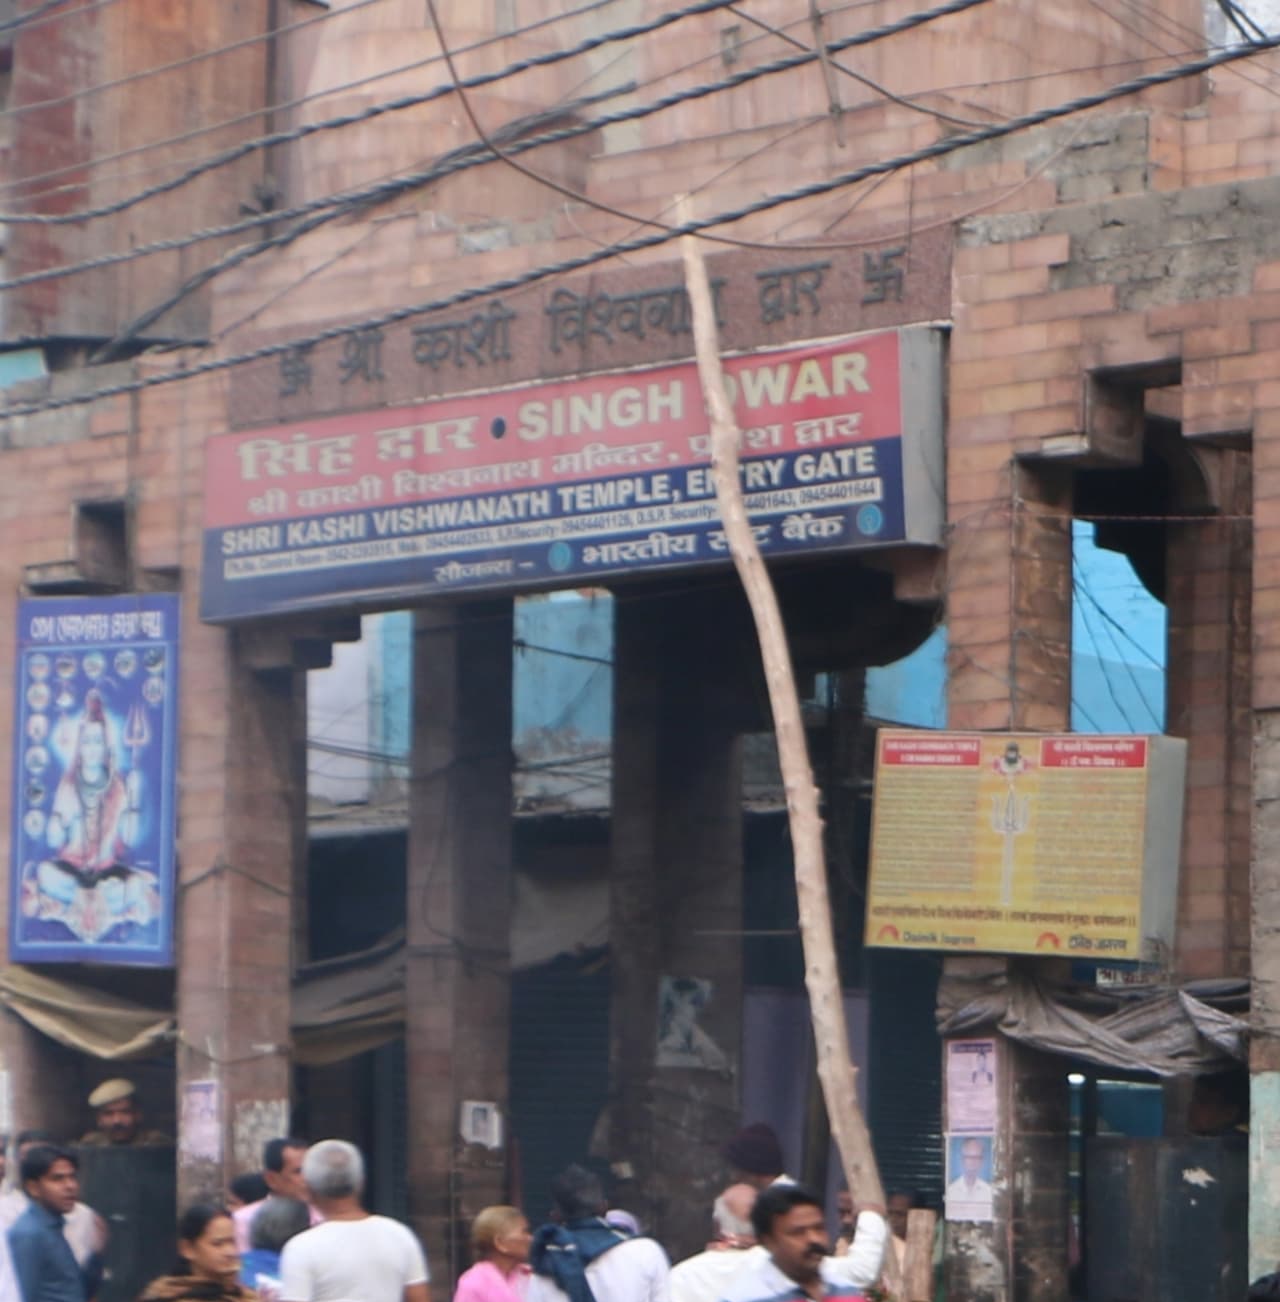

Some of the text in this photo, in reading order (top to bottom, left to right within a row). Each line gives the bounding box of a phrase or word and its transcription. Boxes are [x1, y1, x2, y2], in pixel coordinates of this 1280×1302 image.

[410, 301, 517, 370] काशी
[544, 272, 729, 354] विश्वना
[755, 260, 833, 321] द्वार
[236, 414, 479, 481] सिंह द्वार
[517, 379, 684, 442] SINGH
[222, 446, 877, 555] SHRI KASHI VISHWANATH TEMPLE, ENRY GATE
[246, 488, 289, 517] श्री
[297, 472, 383, 510] काशी
[392, 457, 543, 497] विश्वनाथ
[793, 411, 863, 446] द्वार
[582, 530, 697, 566] भारतीय
[781, 512, 846, 541] बैंक
